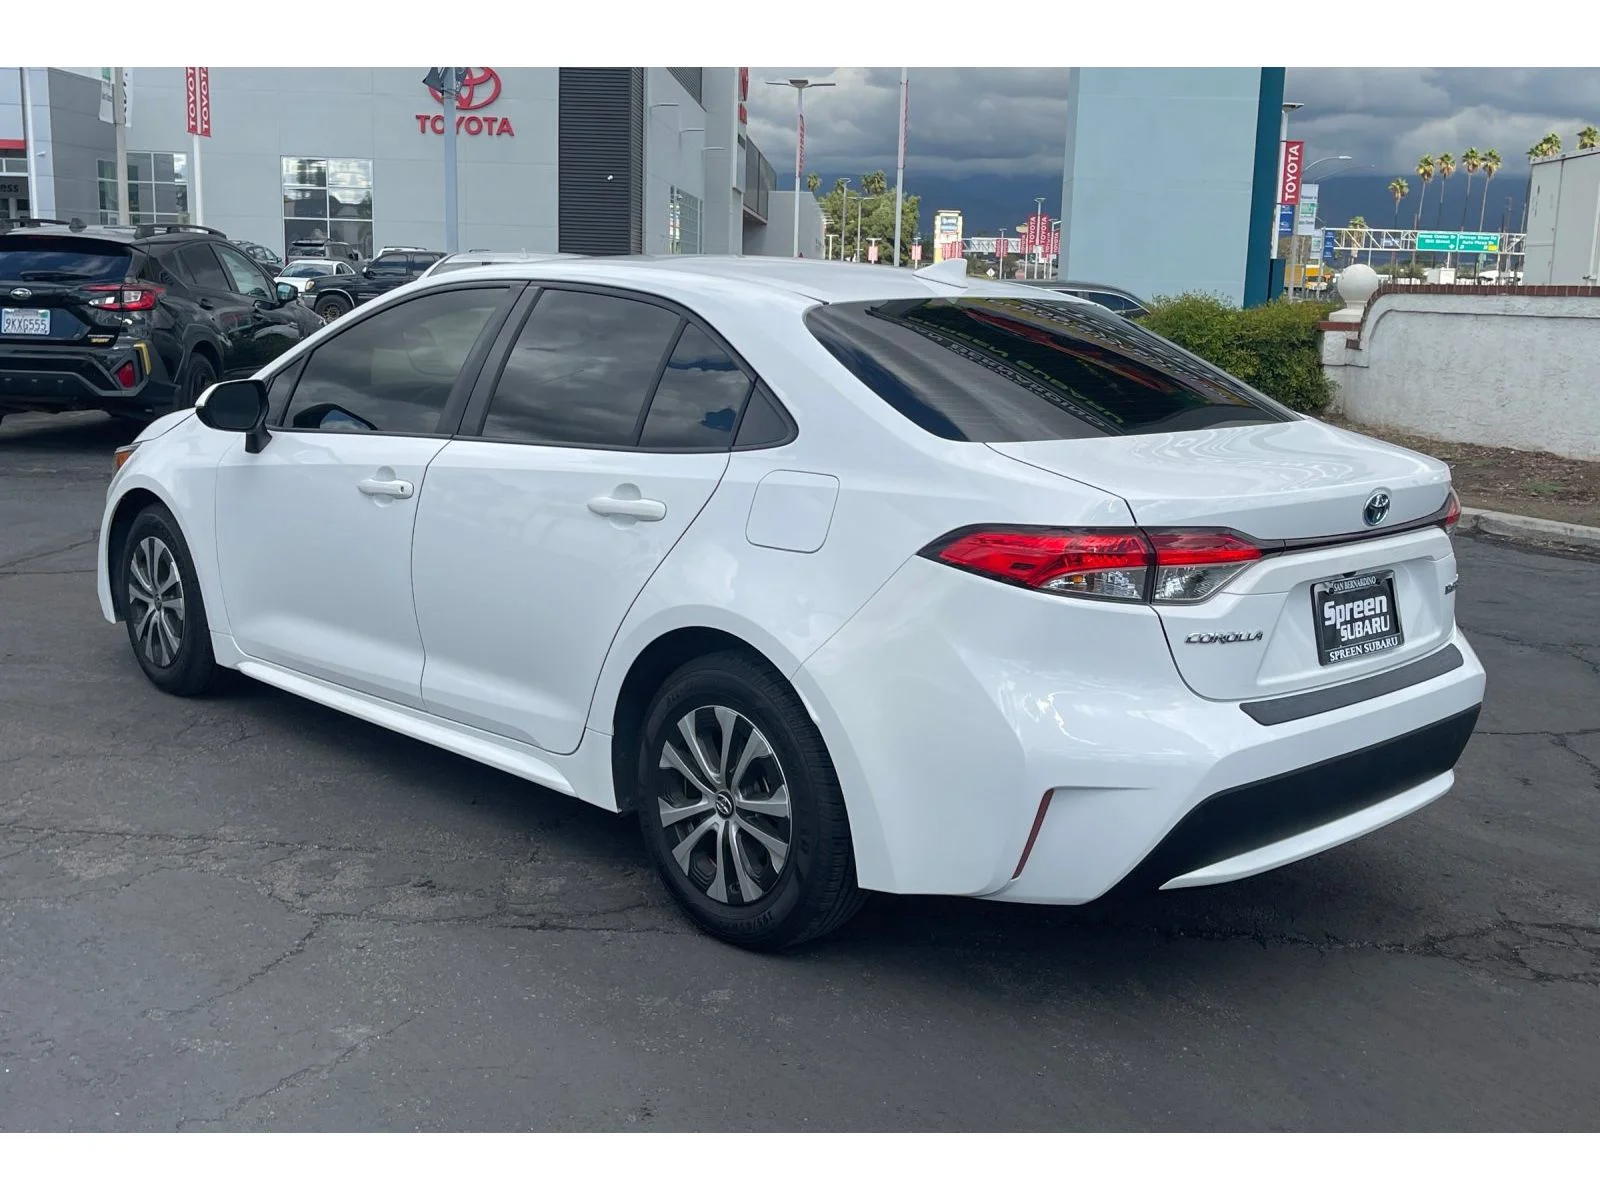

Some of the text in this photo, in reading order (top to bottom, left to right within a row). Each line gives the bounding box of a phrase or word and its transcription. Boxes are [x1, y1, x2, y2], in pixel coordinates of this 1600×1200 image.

[200, 67, 209, 132] TOYOT
[1285, 144, 1300, 201] TOYOTA
[5, 318, 47, 331] 9KXG555
[1333, 576, 1376, 592] SAN BERNARDINO
[1323, 595, 1388, 630] Spreen
[1184, 630, 1263, 645] COROLLA
[1340, 615, 1390, 642] SUBARU
[1329, 636, 1399, 662] SPREEN SUBARU
